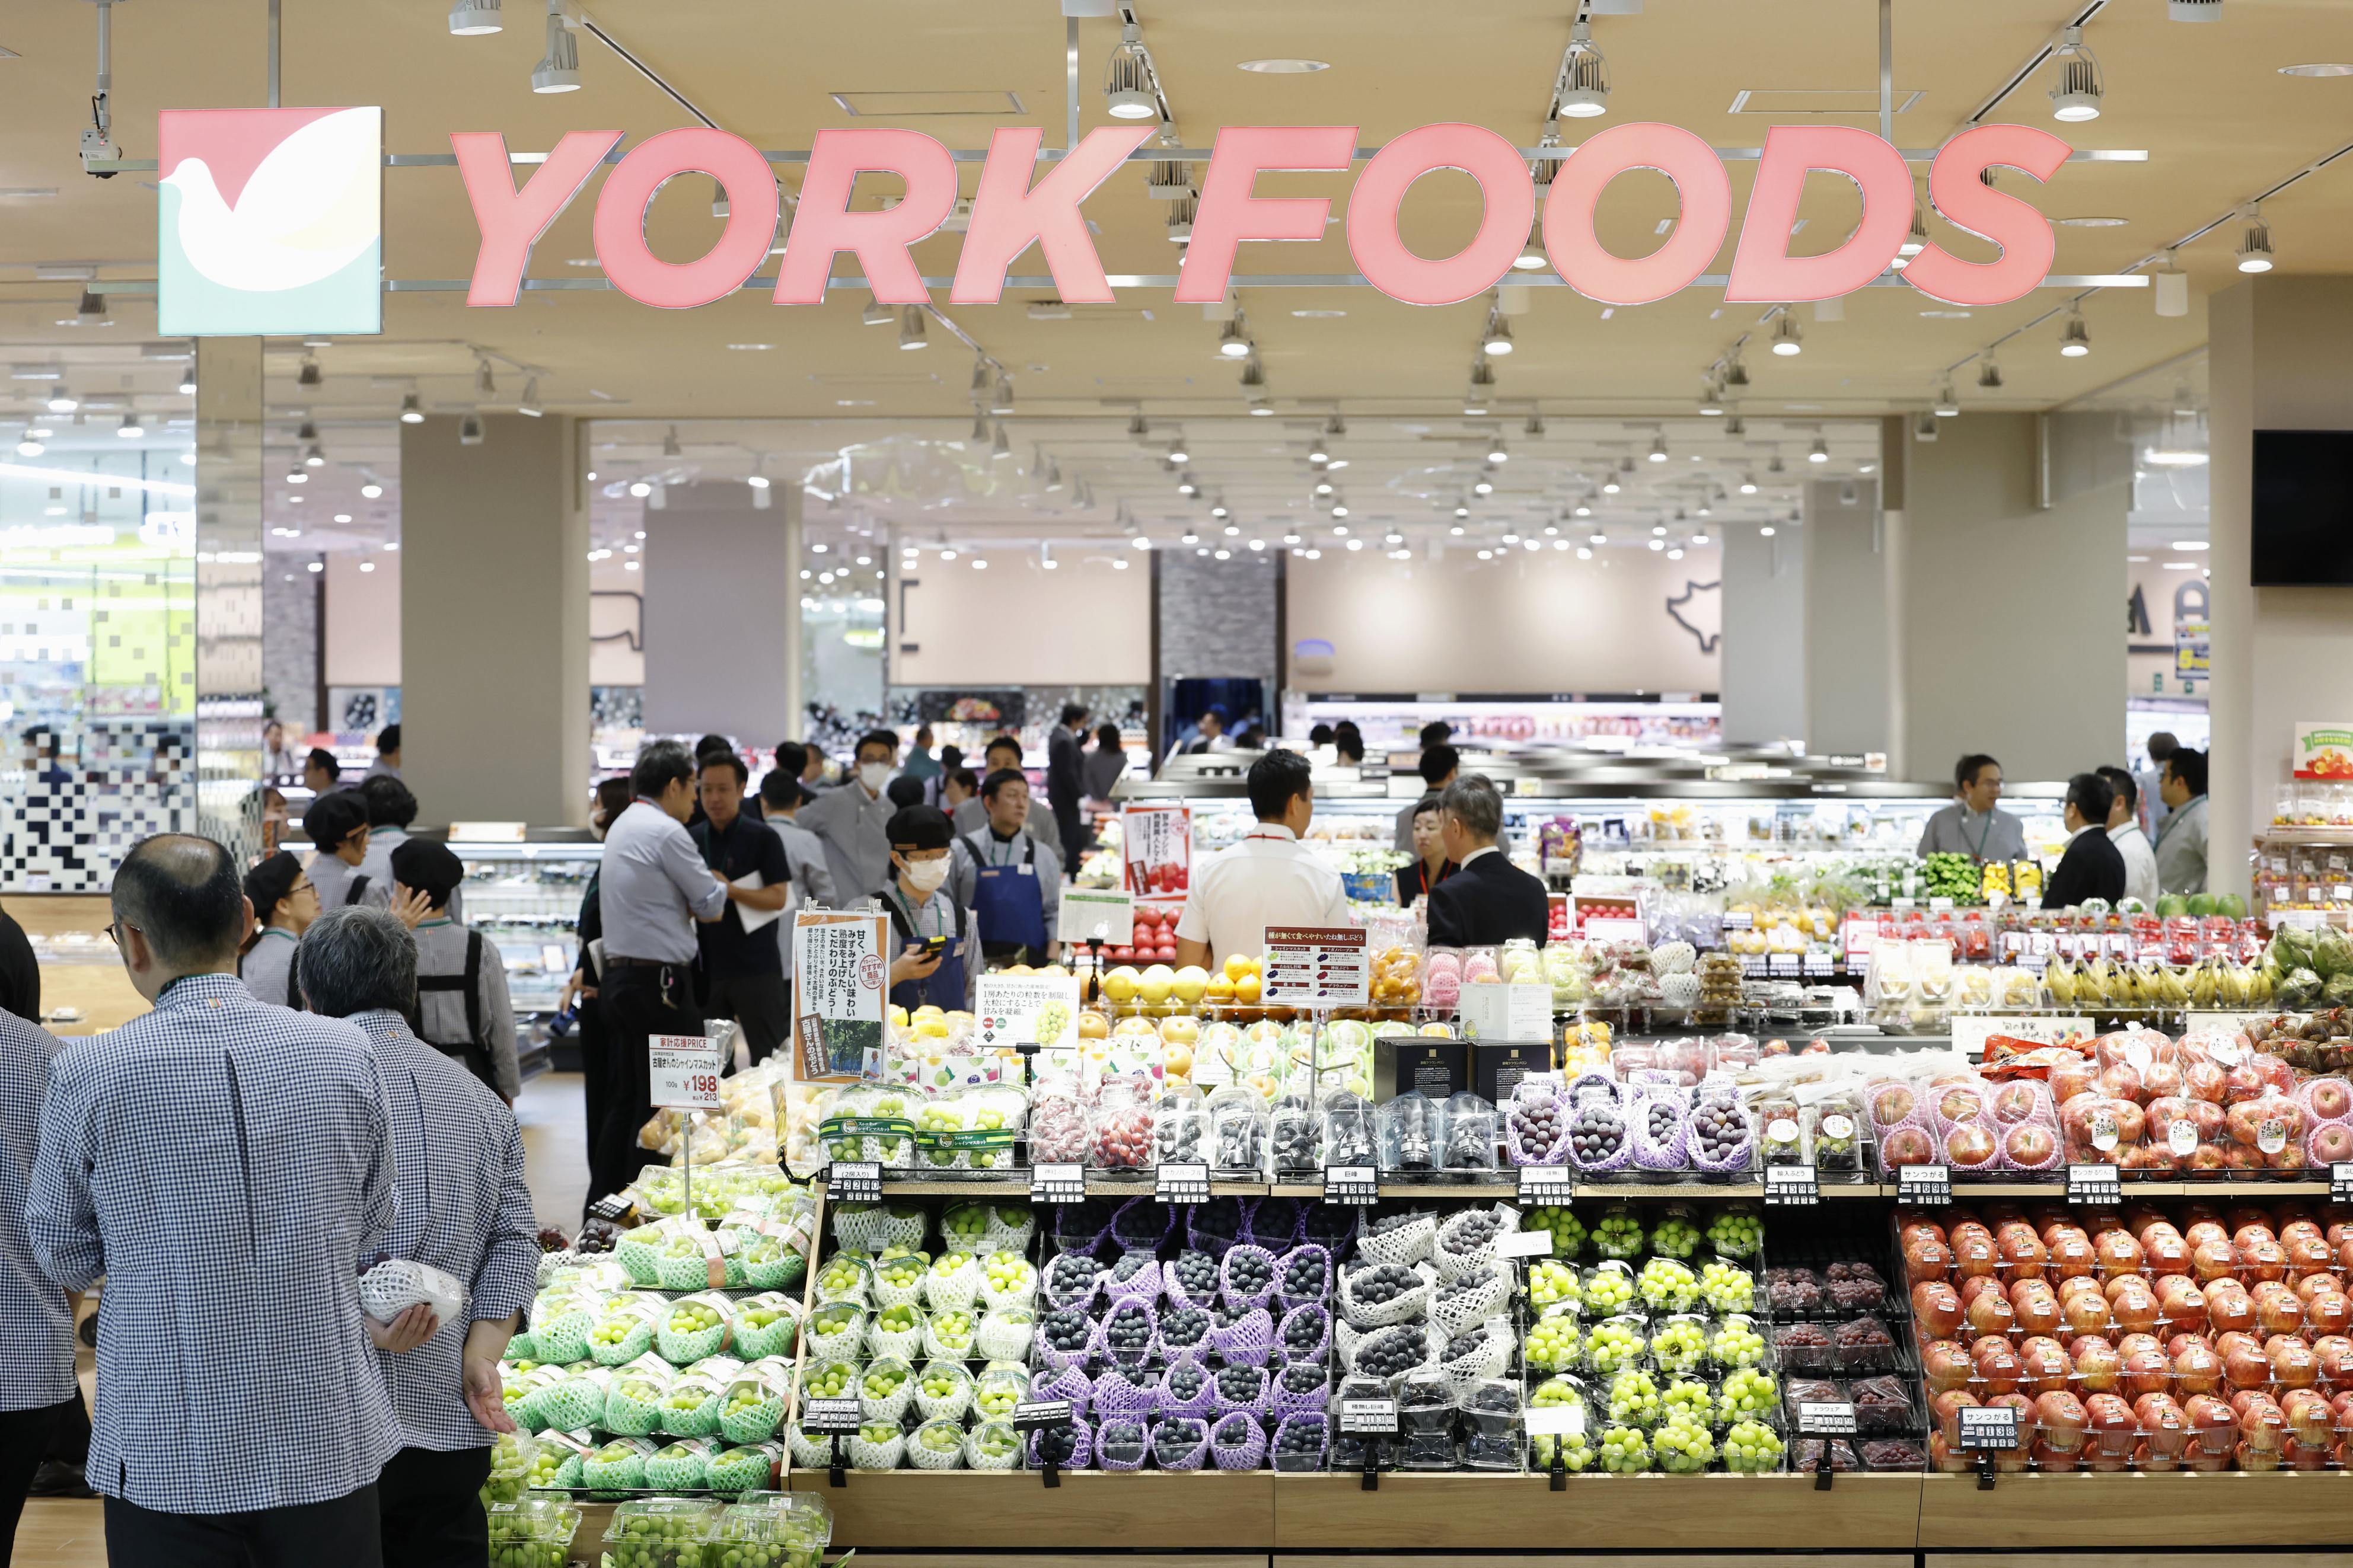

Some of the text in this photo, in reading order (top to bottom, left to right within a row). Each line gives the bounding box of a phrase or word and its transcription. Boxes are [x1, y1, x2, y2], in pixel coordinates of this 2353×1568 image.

[449, 122, 2075, 309] YORK FOODS
[1268, 932, 1363, 941] 種が無くて食べやすいたね無しぶどう
[856, 930, 866, 953] 甘く、
[838, 930, 847, 992] 熟度を上げた、
[861, 963, 882, 972] おすすめ
[847, 930, 856, 1017] みずみずしい味わい
[867, 970, 879, 979] 商品
[983, 999, 1041, 1007] 大粒にすることで
[2003, 1021, 2037, 1030] 旬の果実
[660, 1038, 707, 1048] 家計応援PRICE
[652, 1058, 716, 1070] 古屋さんのシャインマスカット
[683, 1075, 717, 1092] ¥198
[844, 1180, 878, 1189] 2290
[1545, 1184, 1568, 1193] 198
